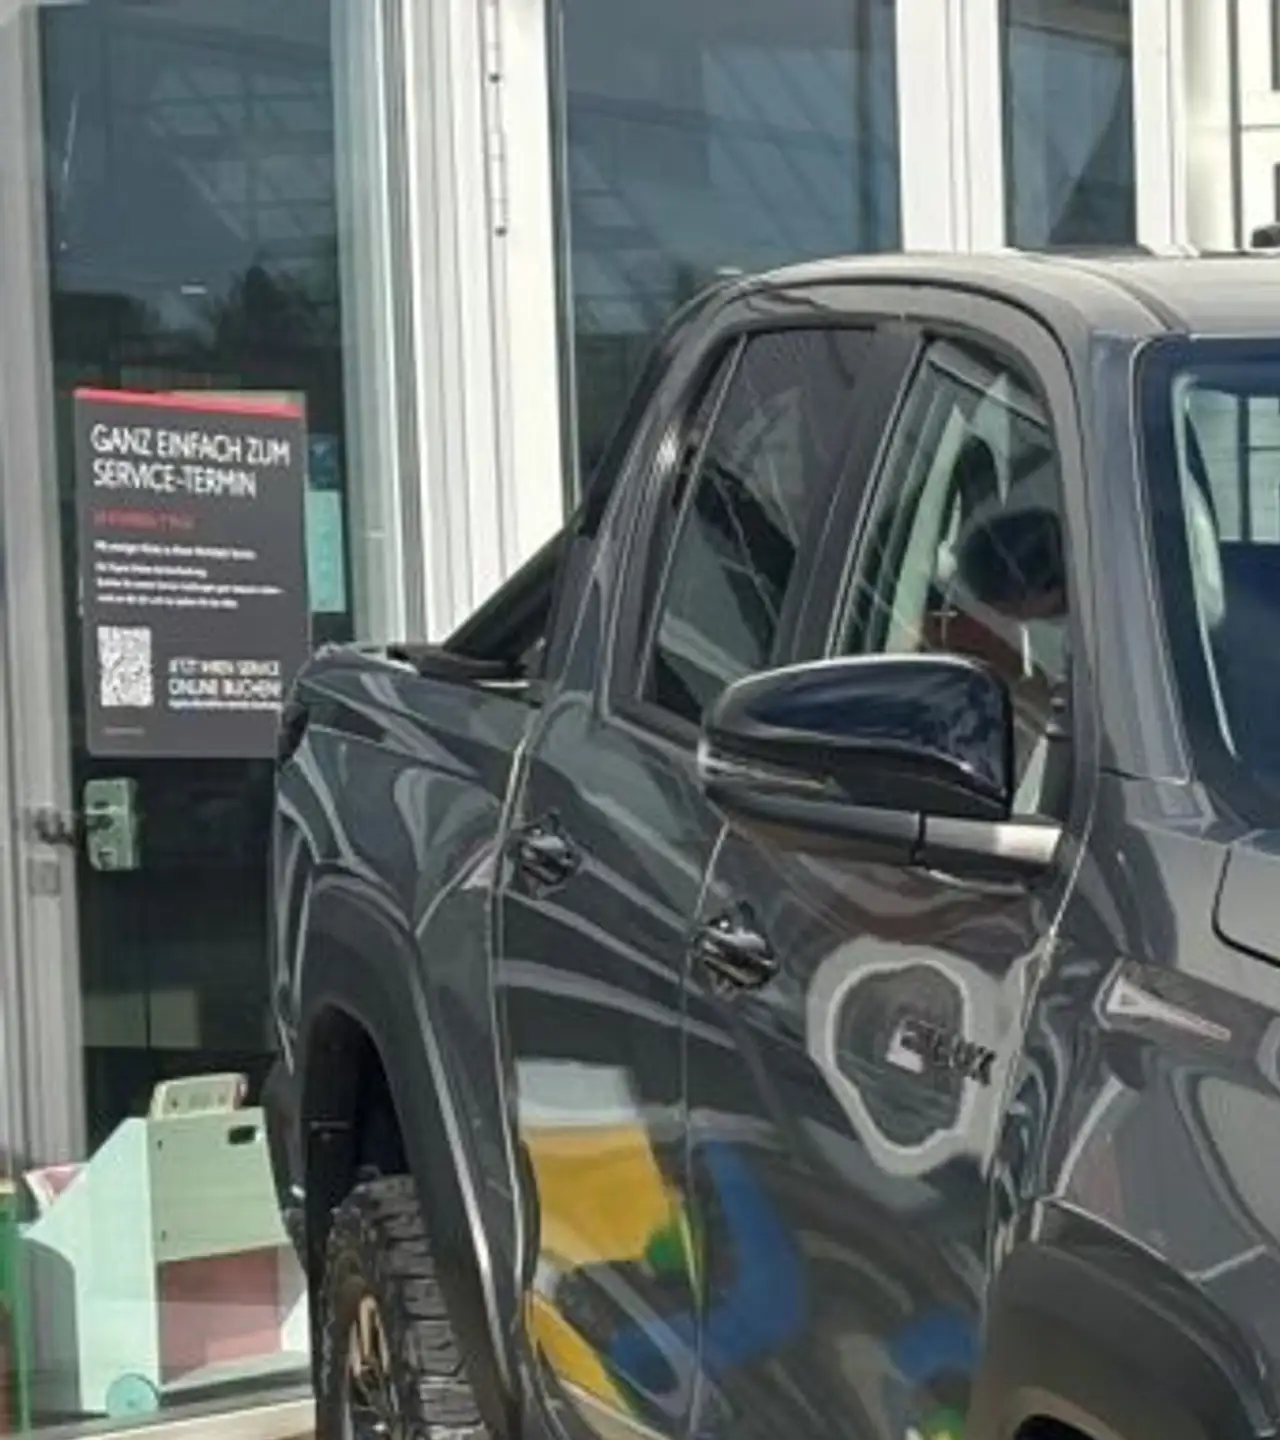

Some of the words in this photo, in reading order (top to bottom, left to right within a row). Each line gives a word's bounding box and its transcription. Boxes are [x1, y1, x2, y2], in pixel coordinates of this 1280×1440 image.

[91, 423, 153, 455] GANZ
[156, 429, 242, 463] EINFACH
[245, 434, 291, 468] ZUM
[93, 457, 258, 498] SERVICE-TERMIN
